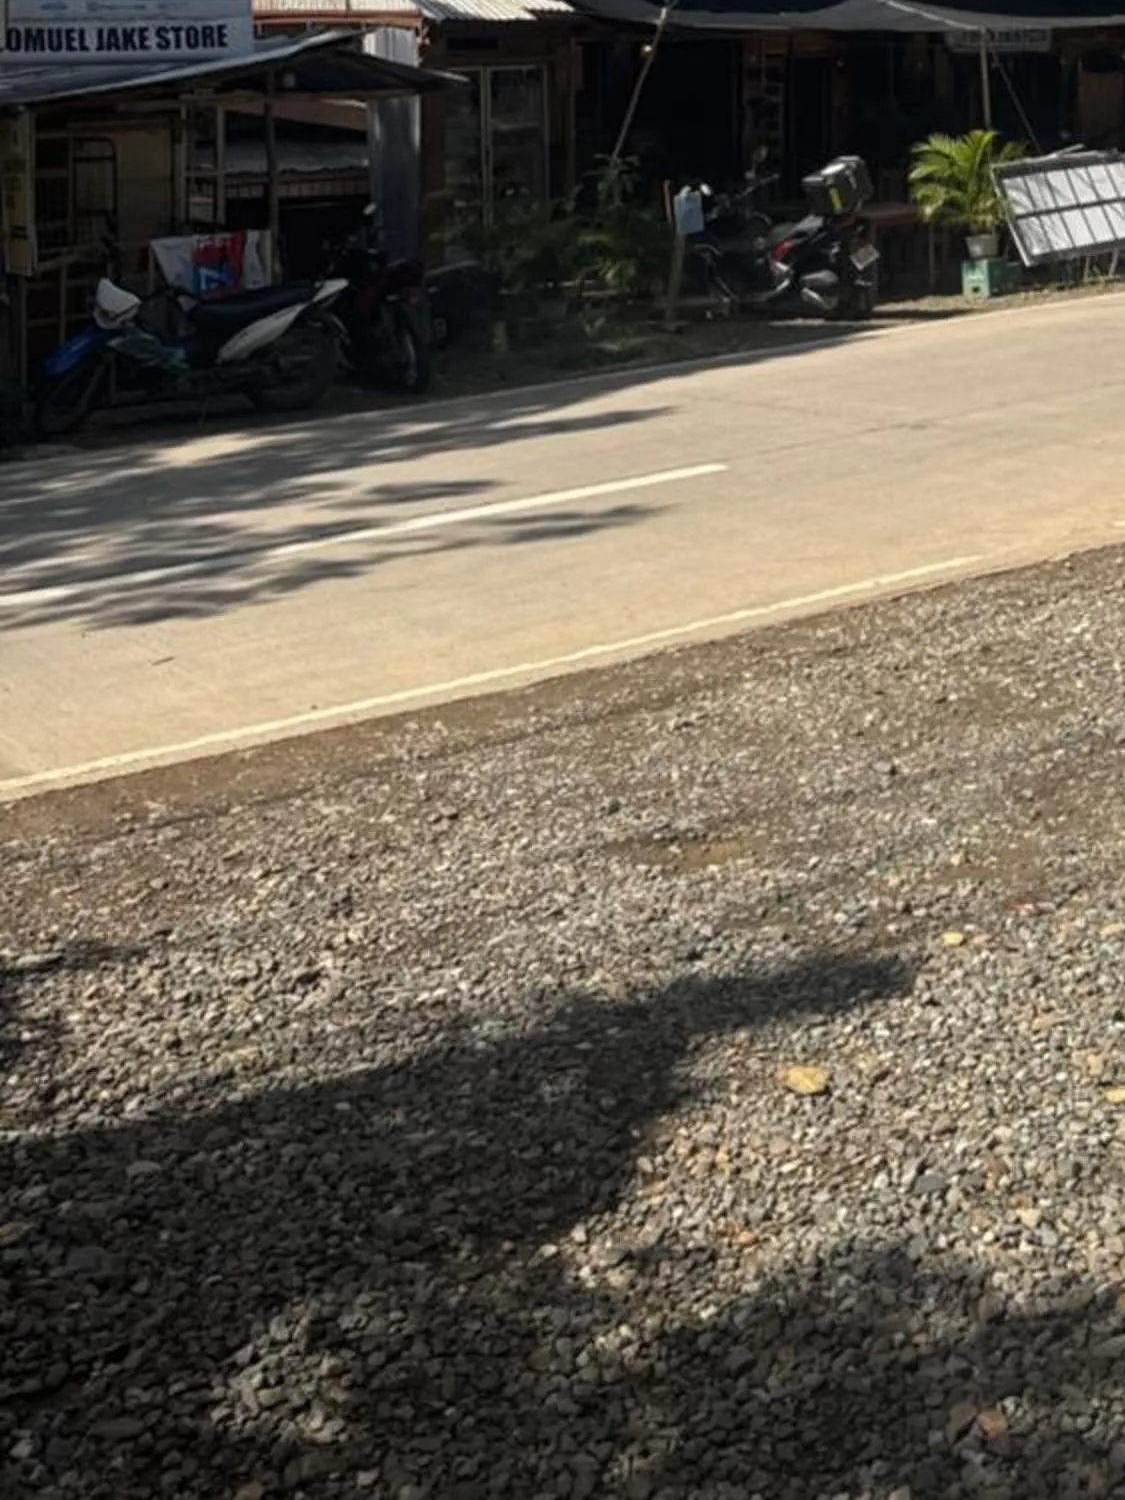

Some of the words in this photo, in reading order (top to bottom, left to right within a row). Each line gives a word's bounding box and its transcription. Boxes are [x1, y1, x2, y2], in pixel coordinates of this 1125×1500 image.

[1, 27, 91, 52] OMUEL
[96, 26, 149, 51] JAKE
[155, 24, 228, 49] STORE
